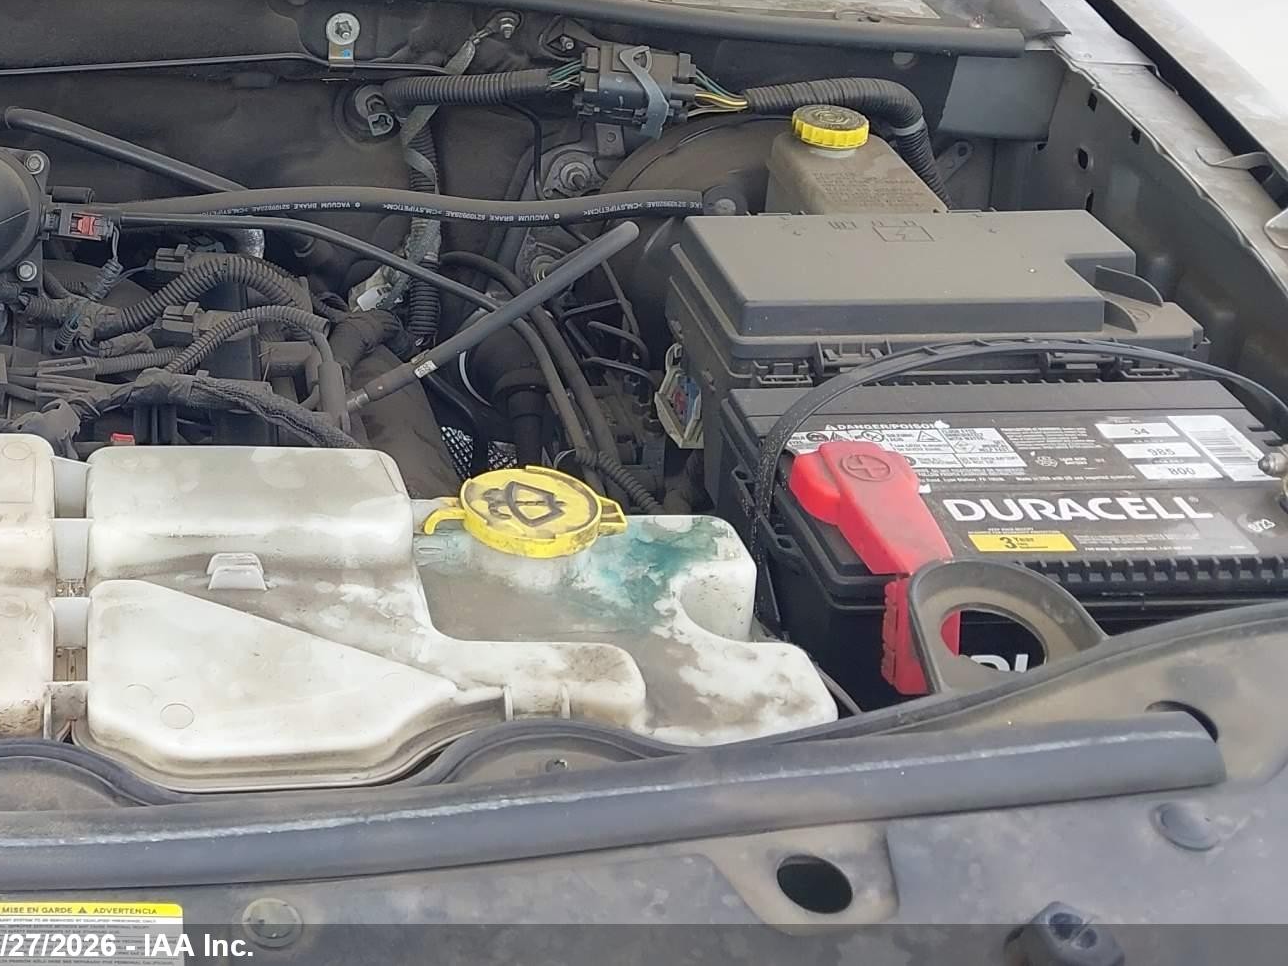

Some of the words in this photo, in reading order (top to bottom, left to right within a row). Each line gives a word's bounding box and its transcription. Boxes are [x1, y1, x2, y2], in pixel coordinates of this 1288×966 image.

[489, 214, 514, 222] BRAKE
[518, 213, 550, 222] VACUUM
[1130, 426, 1150, 435] 34
[942, 497, 1214, 522] DURACELL
[999, 536, 1018, 549] 3
